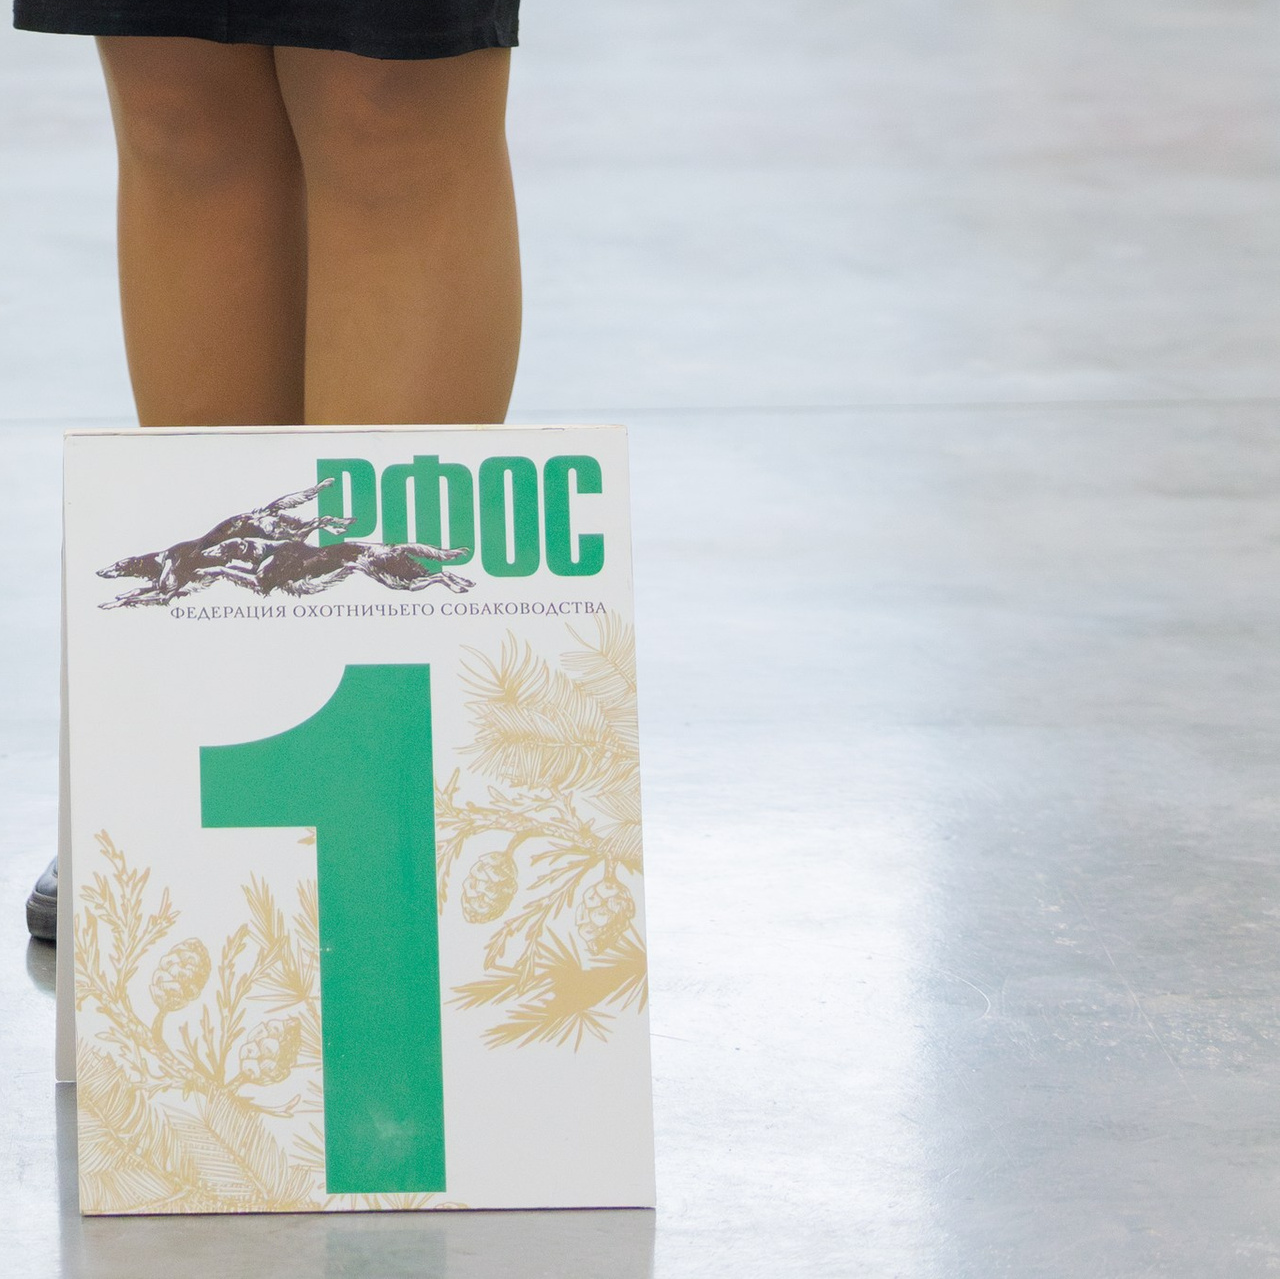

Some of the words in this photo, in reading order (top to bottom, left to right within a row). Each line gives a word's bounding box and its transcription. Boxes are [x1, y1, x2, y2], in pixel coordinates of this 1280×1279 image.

[317, 455, 604, 578] РФОС
[170, 604, 287, 622] ФЕДЕРАЦИЯ
[293, 602, 435, 619] ОХОТНИЧЬЕГО
[440, 600, 607, 617] СОБАКОВОДСТВА
[199, 663, 447, 1194] 1
